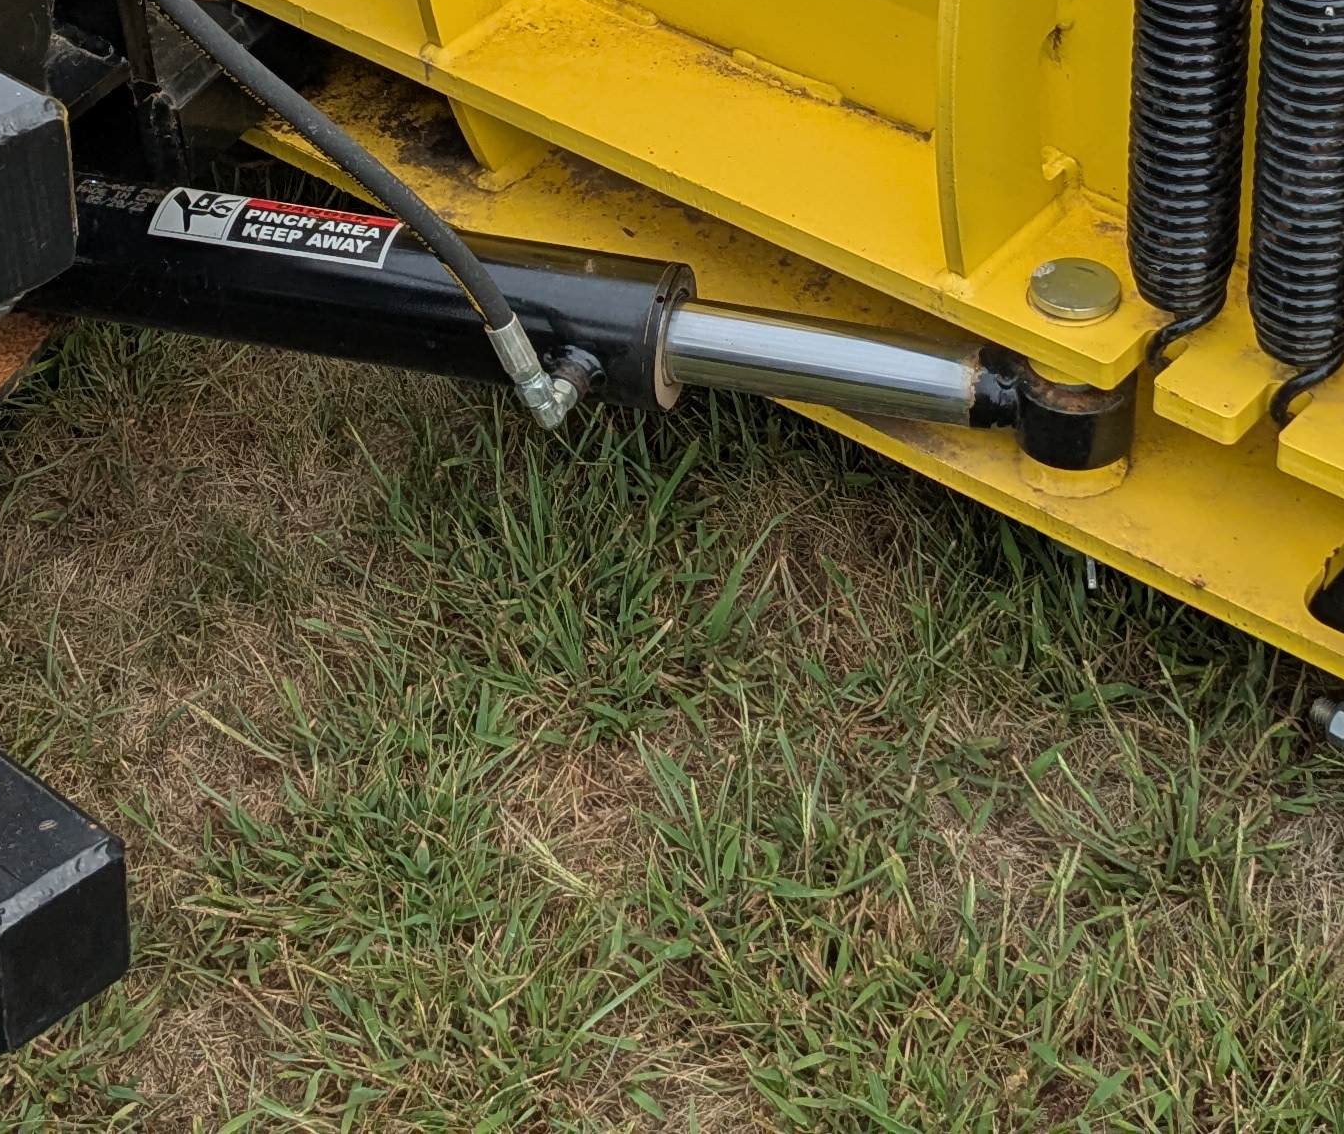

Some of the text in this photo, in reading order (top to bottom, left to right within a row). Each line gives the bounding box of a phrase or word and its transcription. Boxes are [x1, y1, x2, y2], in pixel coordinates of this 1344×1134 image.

[241, 222, 373, 254] KEEP AWAY
[244, 208, 381, 239] PINCH AREA
